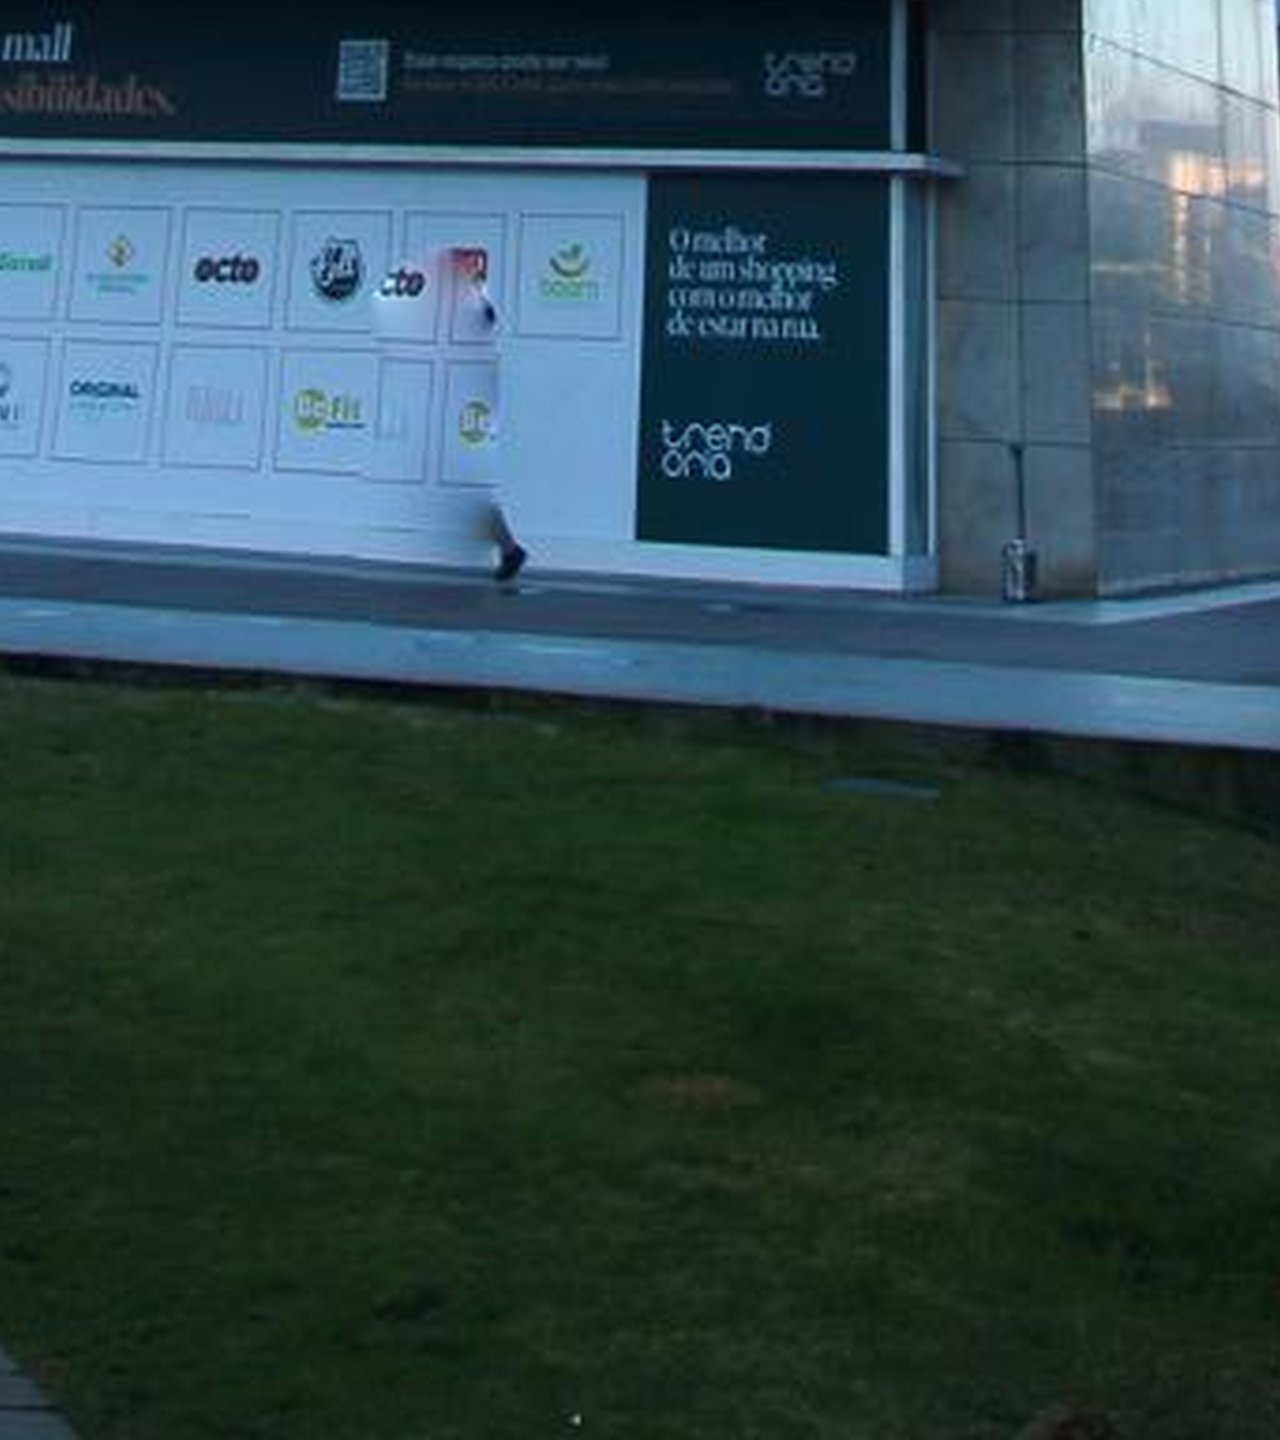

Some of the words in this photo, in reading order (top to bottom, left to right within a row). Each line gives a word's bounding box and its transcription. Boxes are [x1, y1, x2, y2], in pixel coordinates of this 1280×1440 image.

[2, 21, 73, 62] mall
[669, 228, 690, 253] O
[692, 225, 767, 254] melhor
[194, 253, 260, 284] octo
[669, 255, 697, 280] de
[699, 260, 735, 280] um
[668, 288, 716, 309] com
[718, 289, 735, 309] o
[667, 309, 697, 337] de
[661, 418, 772, 455] trend
